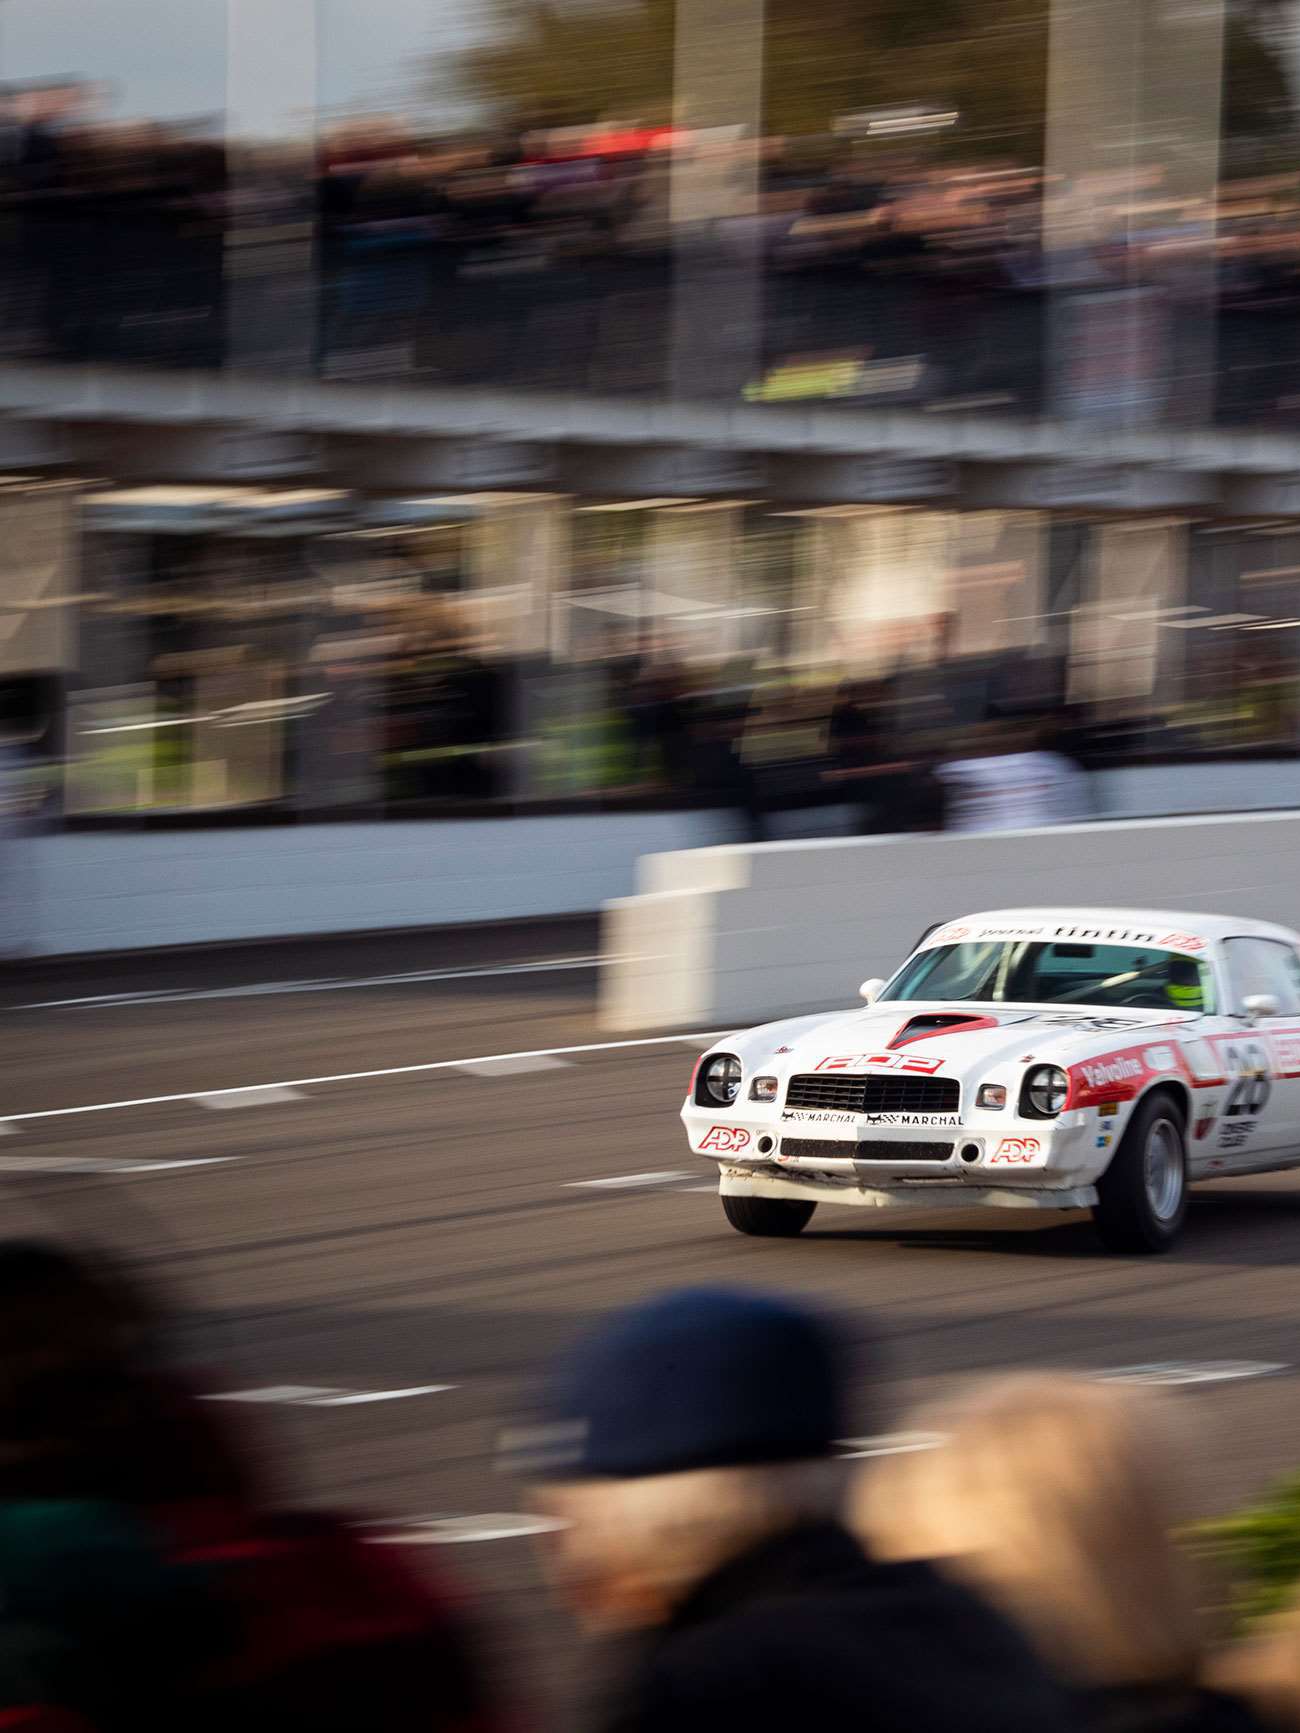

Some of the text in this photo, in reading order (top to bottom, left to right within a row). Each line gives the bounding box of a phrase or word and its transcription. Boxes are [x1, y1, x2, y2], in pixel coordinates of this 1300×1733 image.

[1055, 926, 1156, 942] tintin
[1081, 1057, 1143, 1088] Valvoline
[808, 1112, 857, 1123] MARCHAL
[901, 1115, 965, 1126] MARCHAL
[699, 1126, 750, 1152] ADP
[991, 1137, 1041, 1163] ADP
